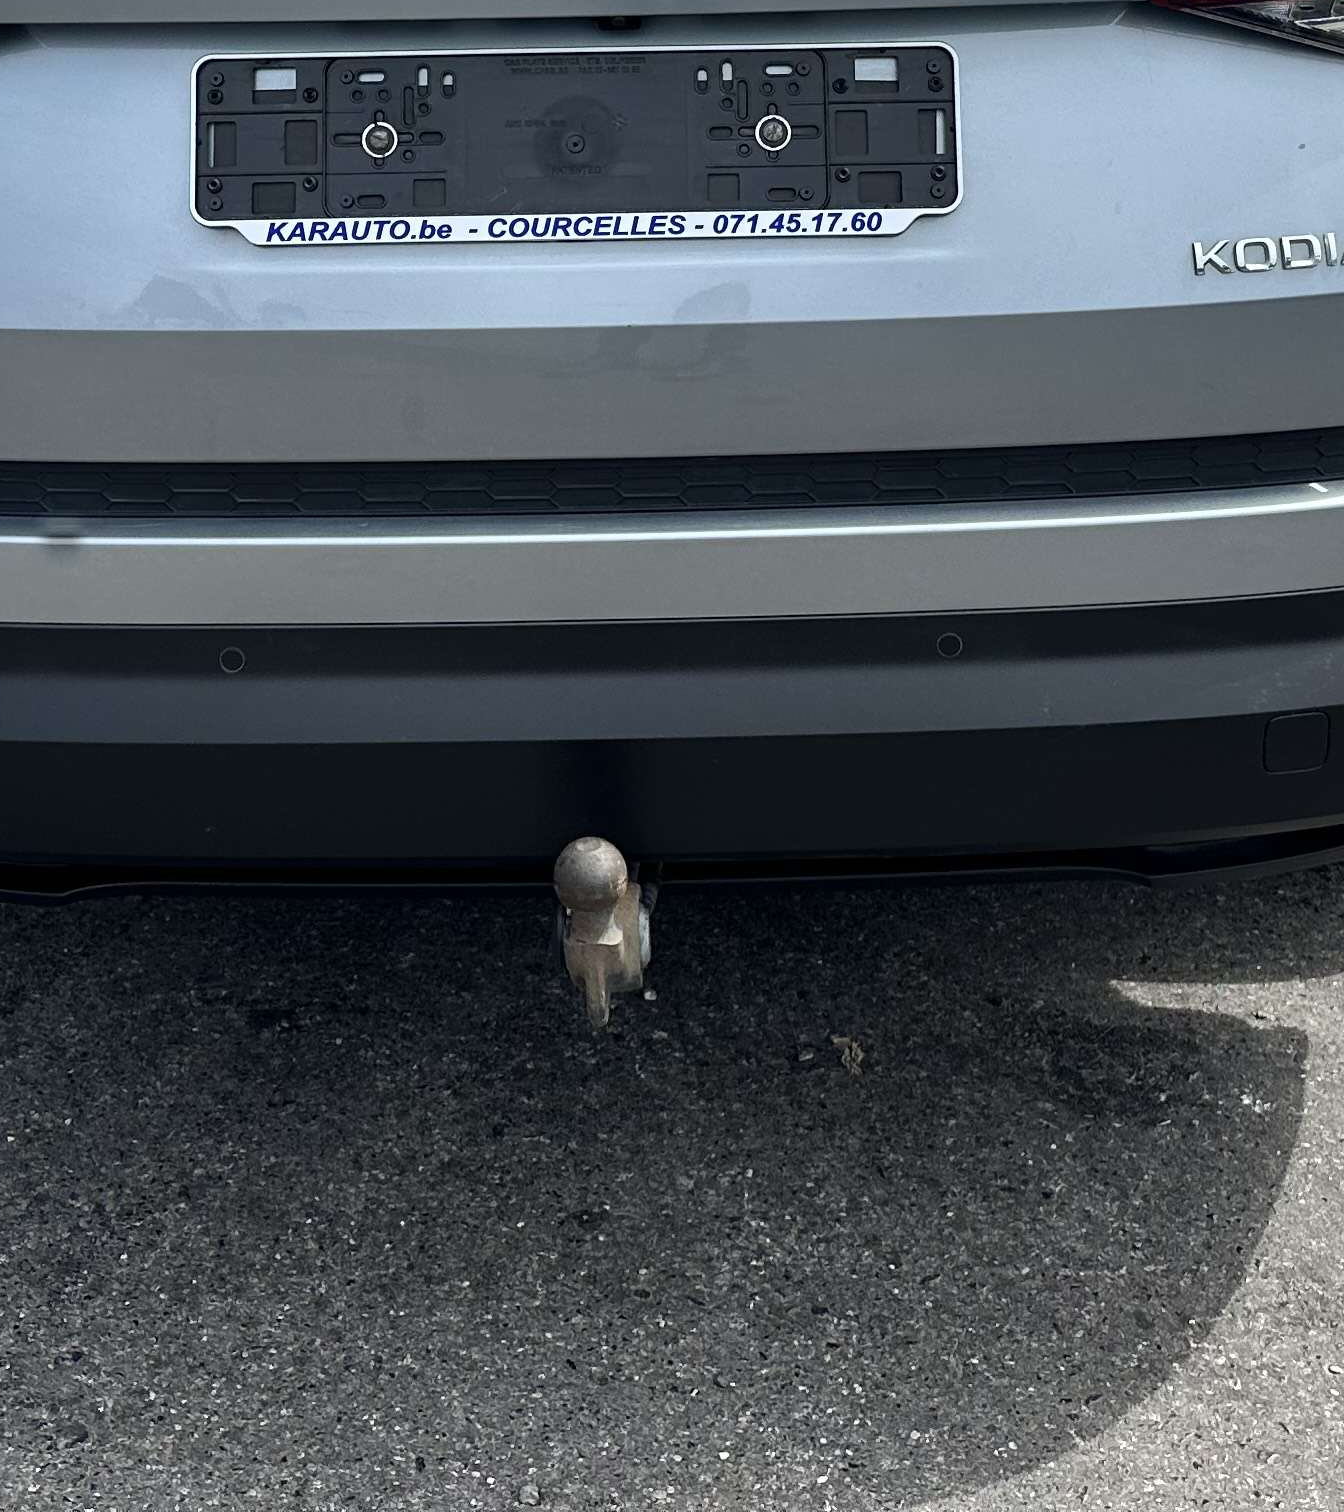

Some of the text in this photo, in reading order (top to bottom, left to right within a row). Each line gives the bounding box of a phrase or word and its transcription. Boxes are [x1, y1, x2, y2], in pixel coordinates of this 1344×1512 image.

[265, 220, 453, 243] KARAUTO.be
[487, 214, 687, 239] COURCELLES
[712, 211, 884, 235] 071.45.17.60
